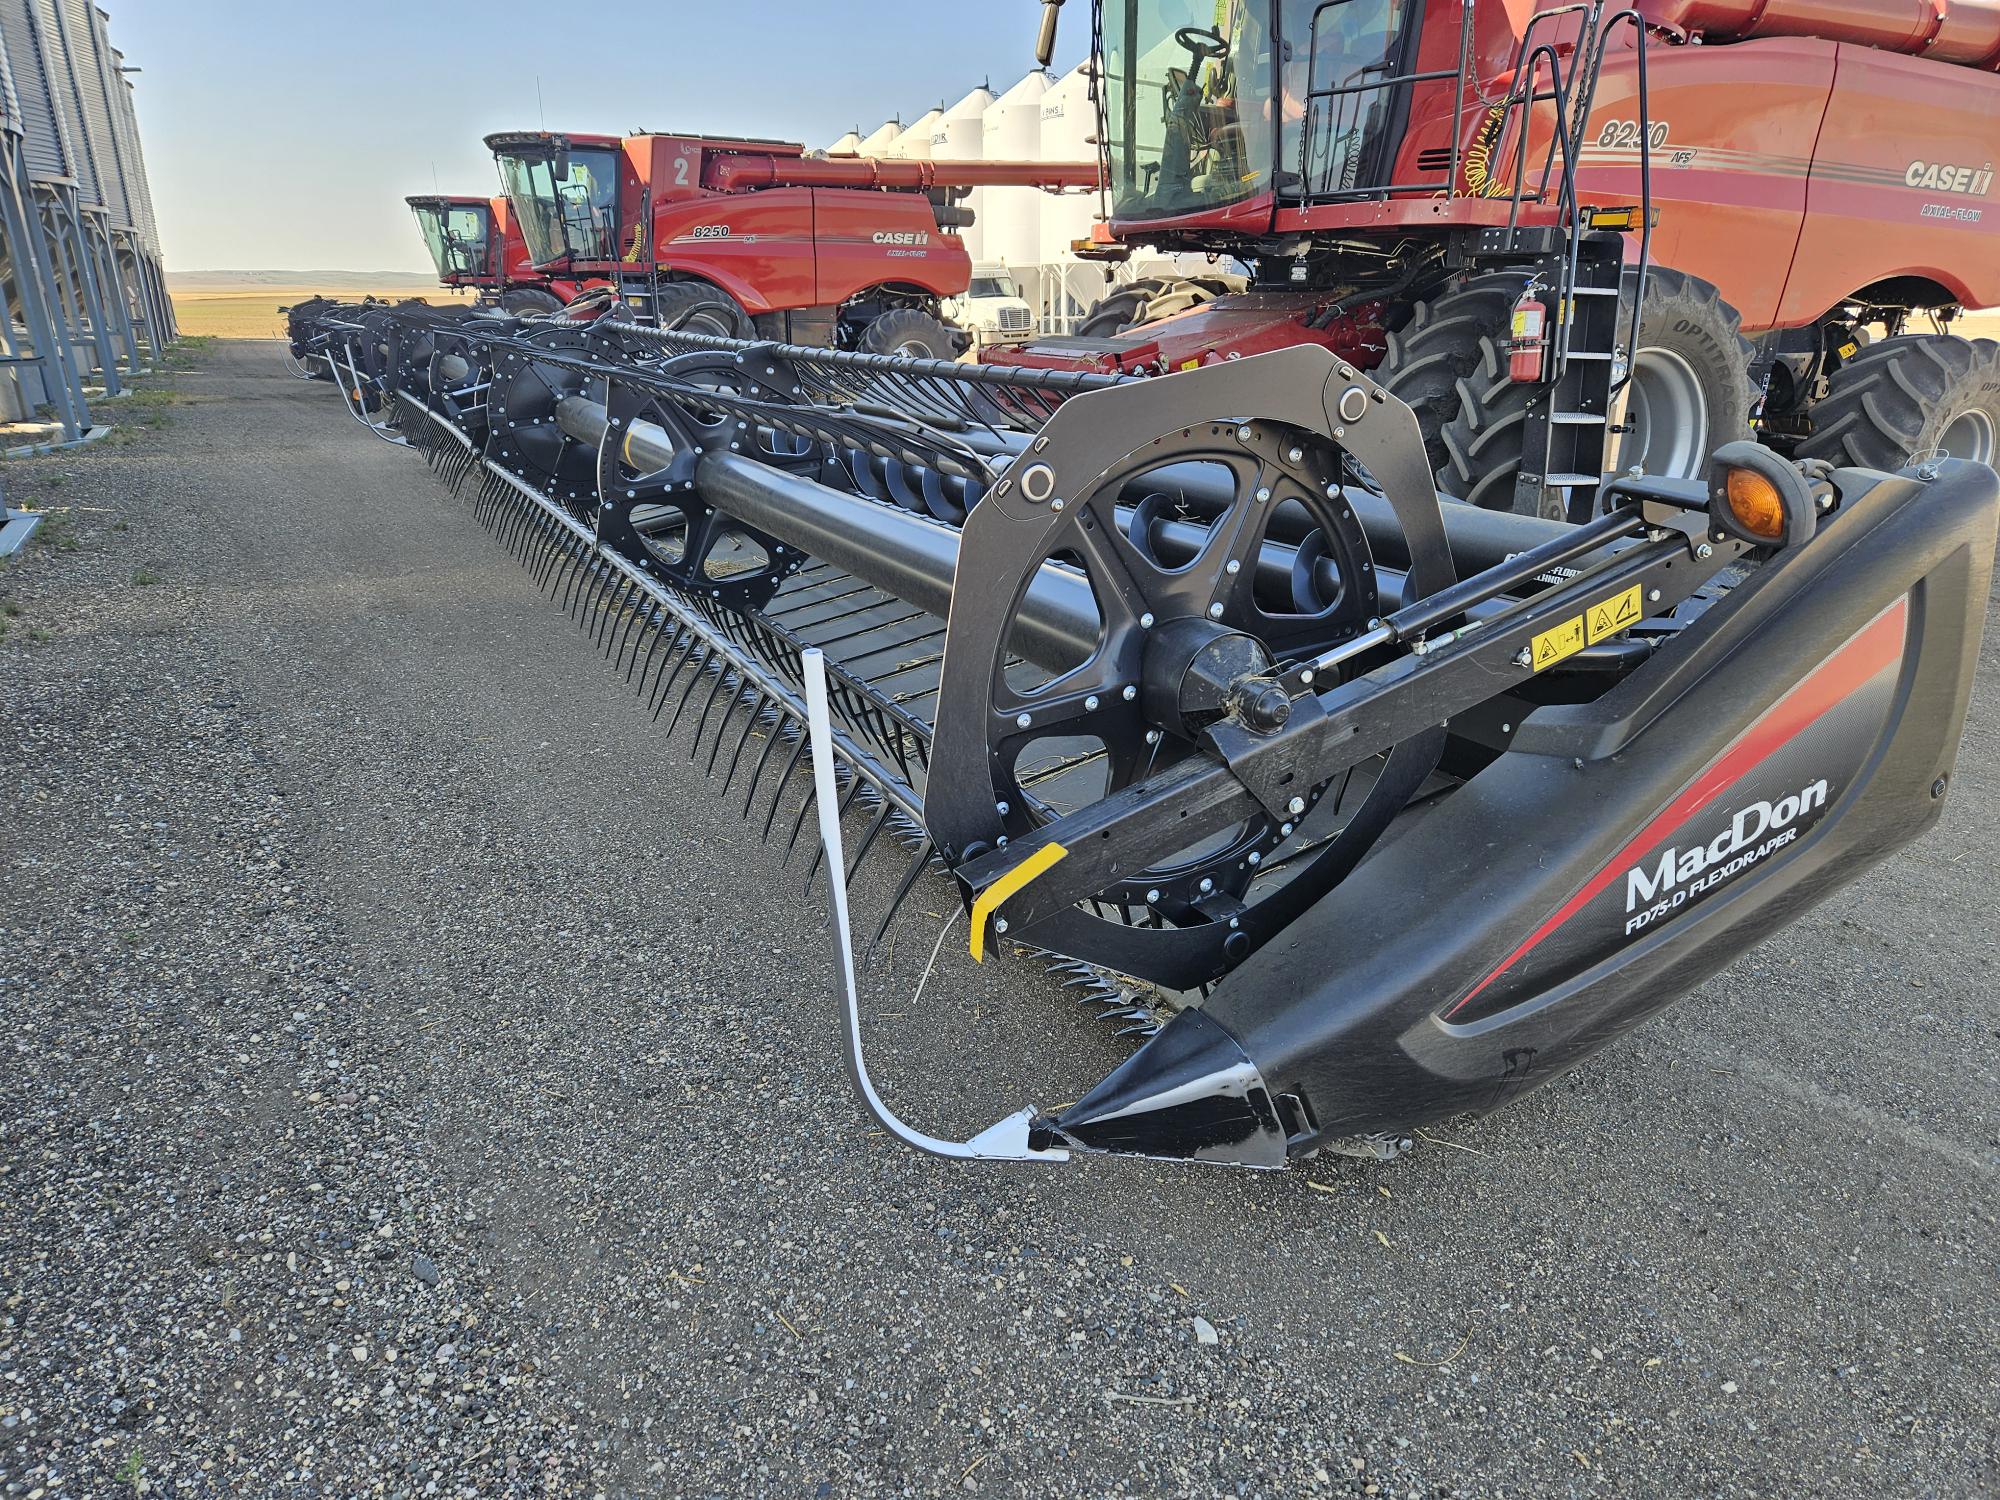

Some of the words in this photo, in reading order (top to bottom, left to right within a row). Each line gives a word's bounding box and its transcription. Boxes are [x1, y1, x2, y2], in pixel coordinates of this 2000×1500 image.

[673, 157, 689, 185] 2
[1905, 161, 1962, 192] CASE
[1920, 204, 1982, 222] AXIAL-FLOW
[693, 225, 730, 238] 8250
[872, 231, 914, 245] CASE
[1626, 779, 1828, 913] MacDon
[1625, 890, 1687, 936] FD75-D
[1689, 827, 1797, 898] FLEXDRAPER
